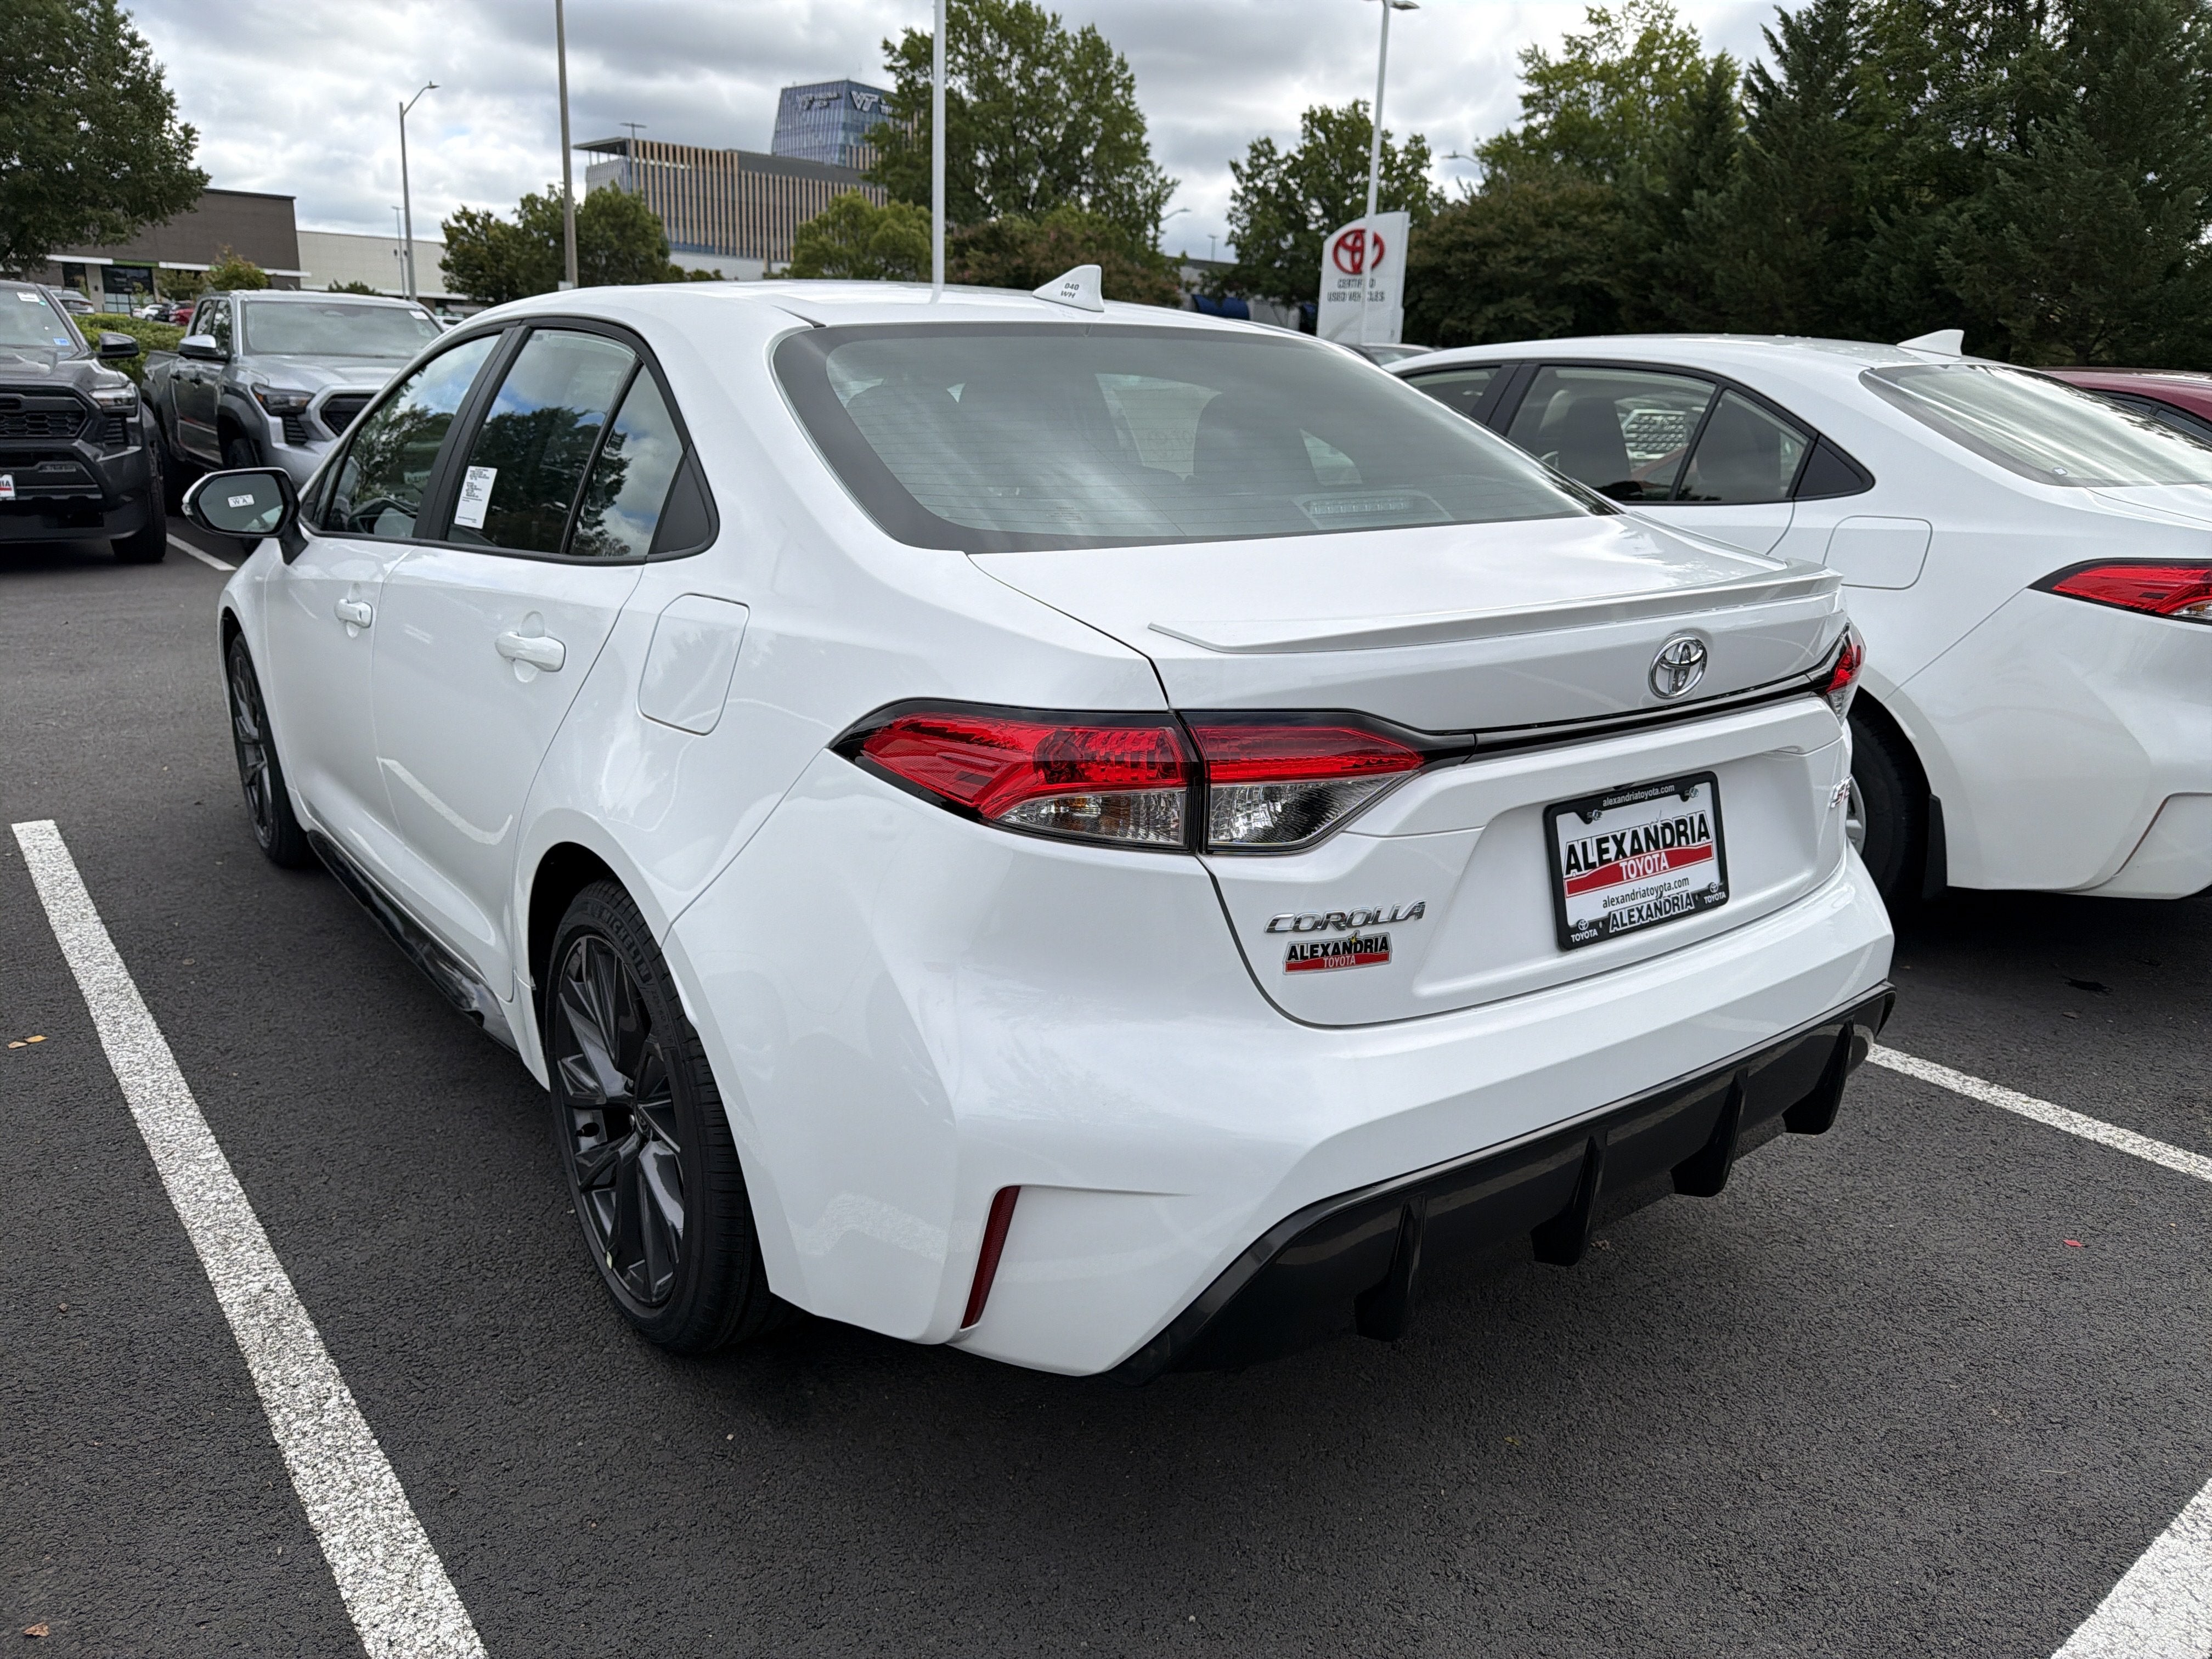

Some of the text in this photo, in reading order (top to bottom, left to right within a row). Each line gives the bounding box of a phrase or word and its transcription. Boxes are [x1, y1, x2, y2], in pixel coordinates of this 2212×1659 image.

[1337, 278, 1376, 289] CERTID
[1347, 291, 1386, 302] VEHLES
[1602, 785, 1675, 807] alexandriatoyota.com
[1565, 812, 1711, 876] ALEXANDRIA
[1620, 851, 1669, 881] TOYOTA
[1602, 877, 1690, 909] alexandriatoyota.com
[1703, 891, 1726, 904] TOYOTA
[1264, 899, 1427, 933] COROLLA
[1609, 891, 1695, 933] ALEXANDRIA
[601, 909, 653, 984] MICHELIN
[1287, 935, 1390, 961] ALEXANDRIA
[1571, 928, 1599, 943] TOYOTA
[1323, 954, 1356, 968] TOYOTA
